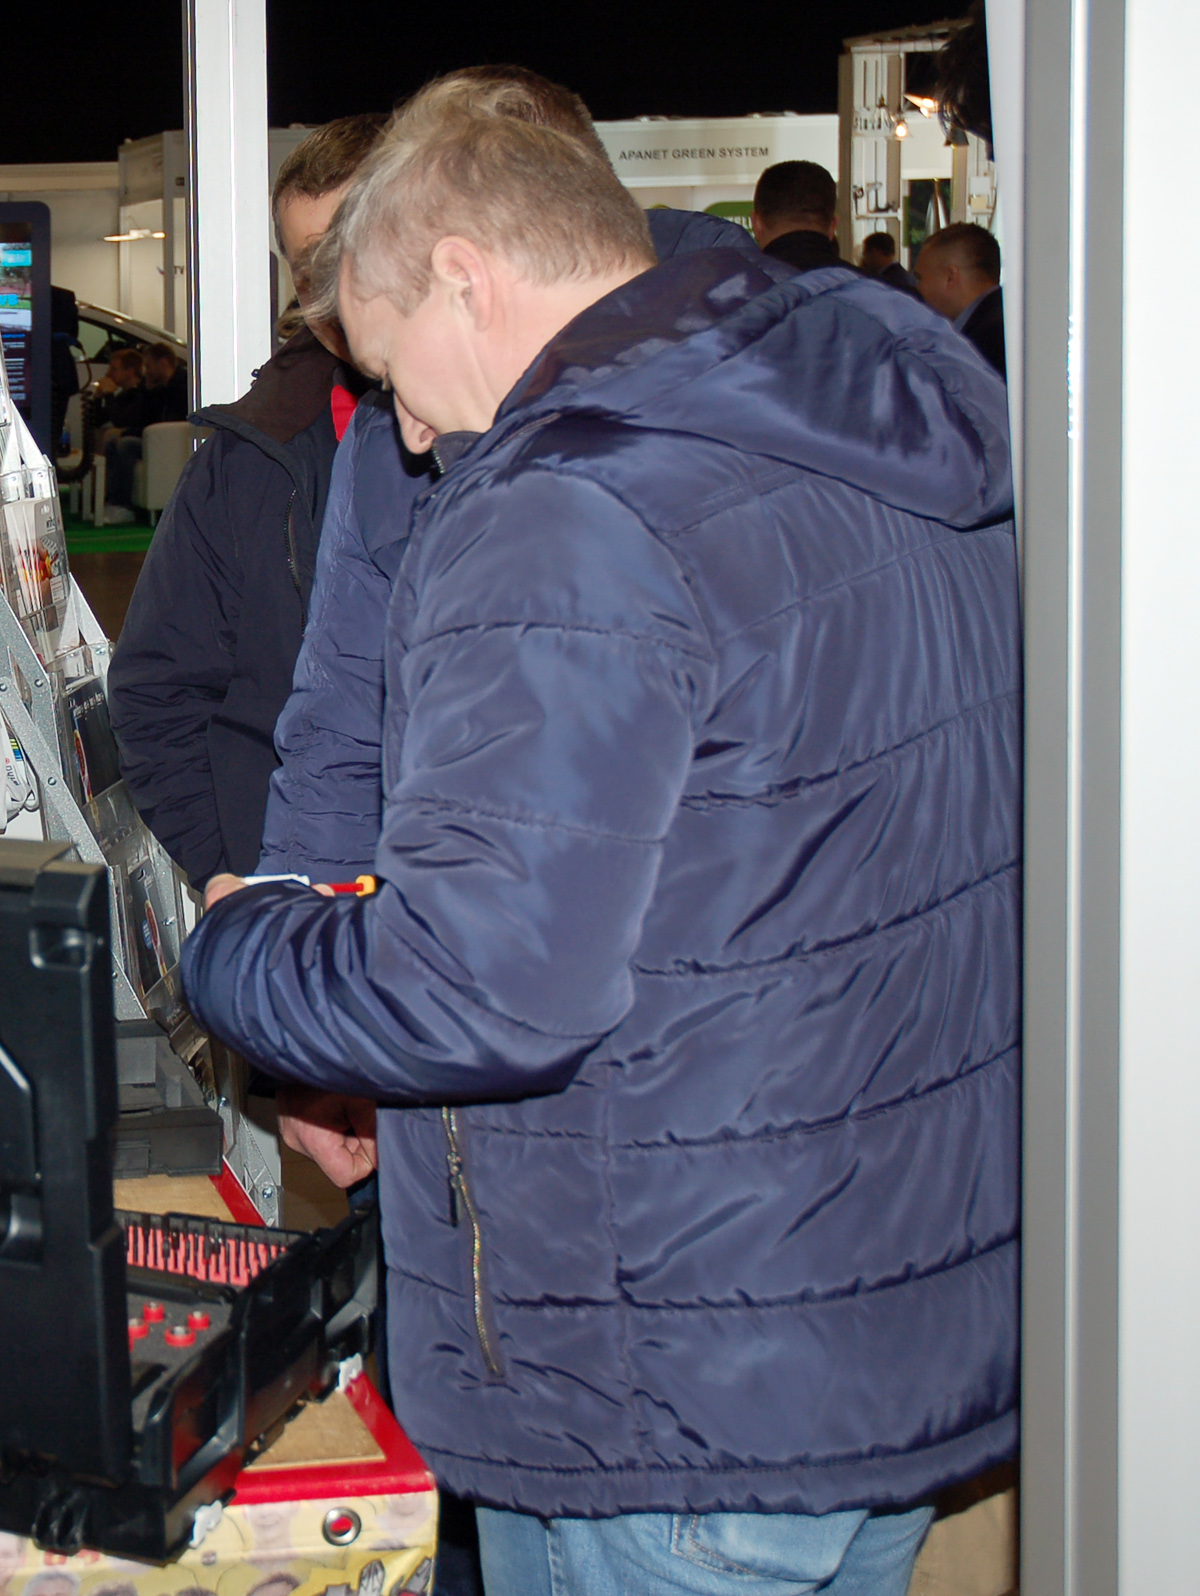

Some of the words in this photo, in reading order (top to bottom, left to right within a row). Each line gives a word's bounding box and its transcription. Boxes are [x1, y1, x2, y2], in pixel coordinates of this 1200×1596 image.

[618, 150, 669, 161] APANET
[672, 148, 716, 160] GREEN
[719, 147, 769, 159] SYSTEM
